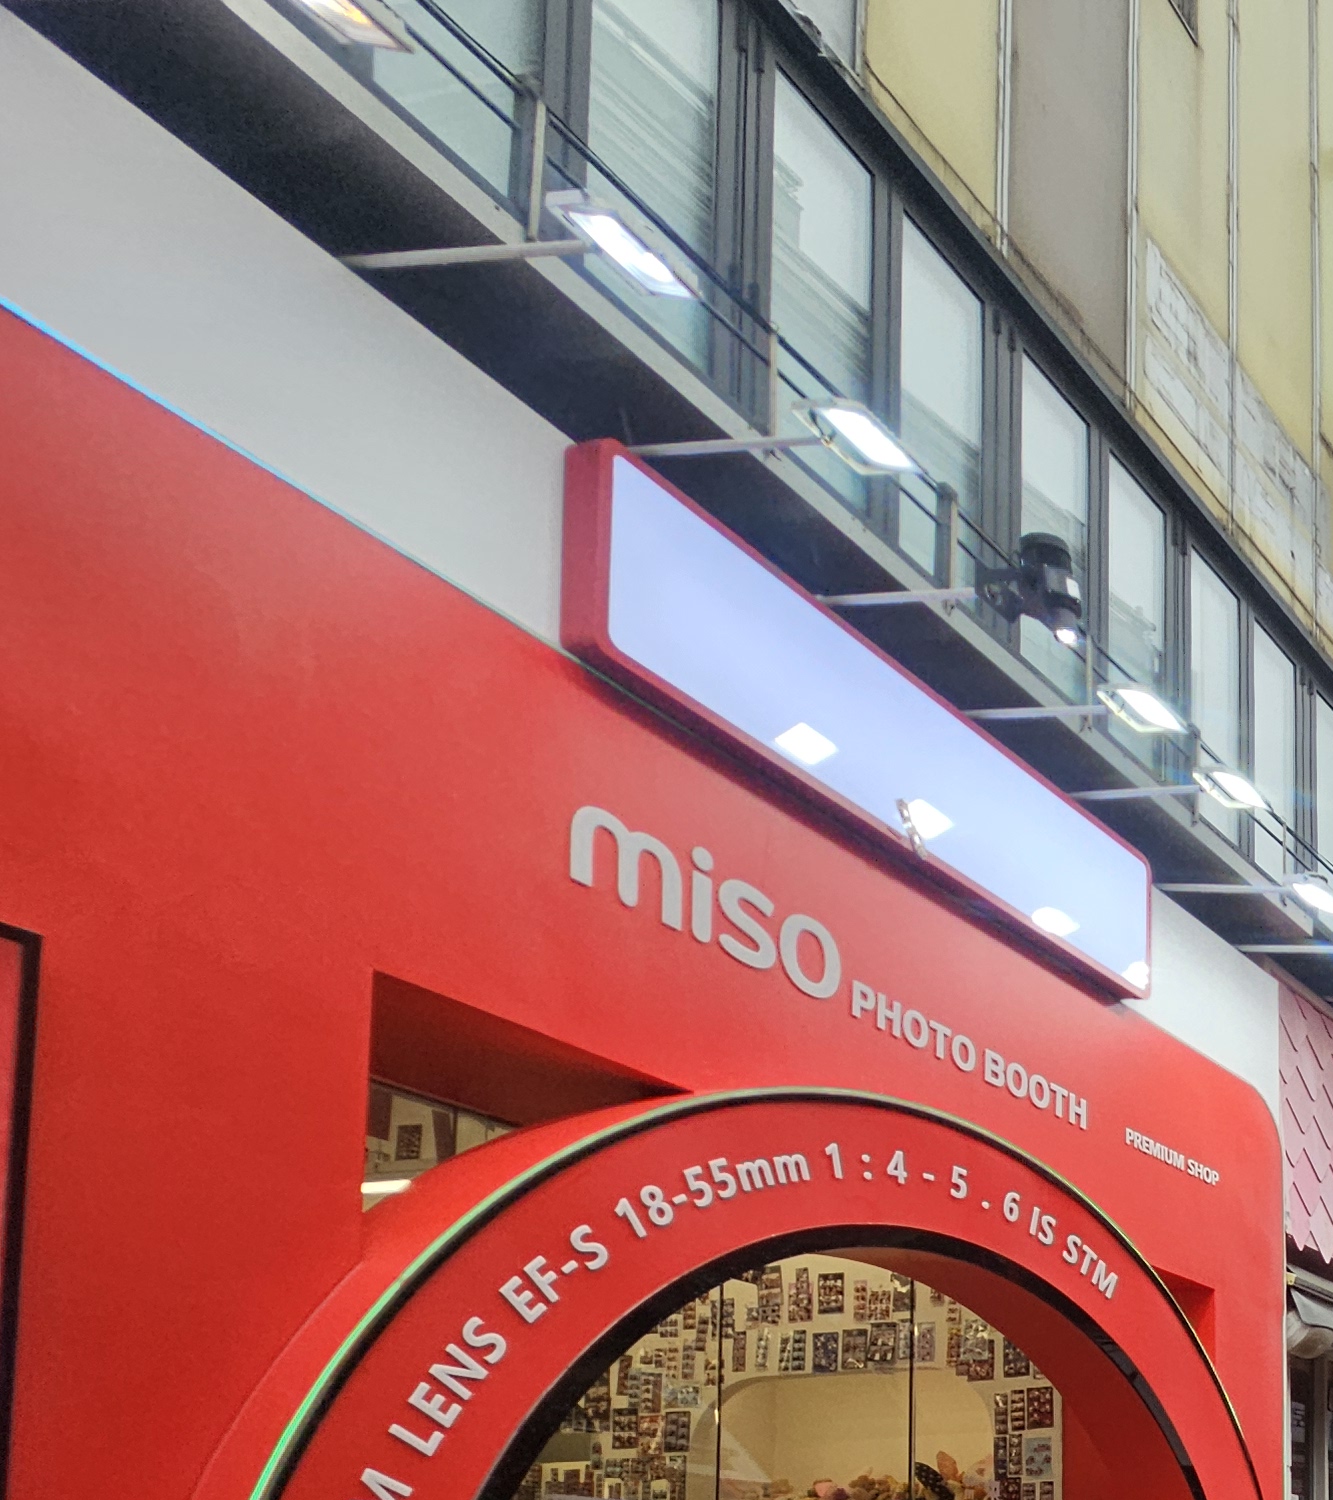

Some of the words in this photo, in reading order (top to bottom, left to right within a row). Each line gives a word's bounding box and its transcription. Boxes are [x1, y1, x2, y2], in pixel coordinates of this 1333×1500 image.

[568, 803, 843, 1001] miso
[850, 980, 979, 1075] PHOTO
[983, 1049, 1089, 1132] BOOTH
[386, 1313, 510, 1458] LENS
[496, 1224, 610, 1328] EF-S
[613, 1146, 813, 1241] 18-55mm
[1028, 1205, 1057, 1247] IS
[1061, 1232, 1120, 1300] STM
[1124, 1126, 1187, 1173] PREMIUM
[1186, 1152, 1221, 1187] SHOP
